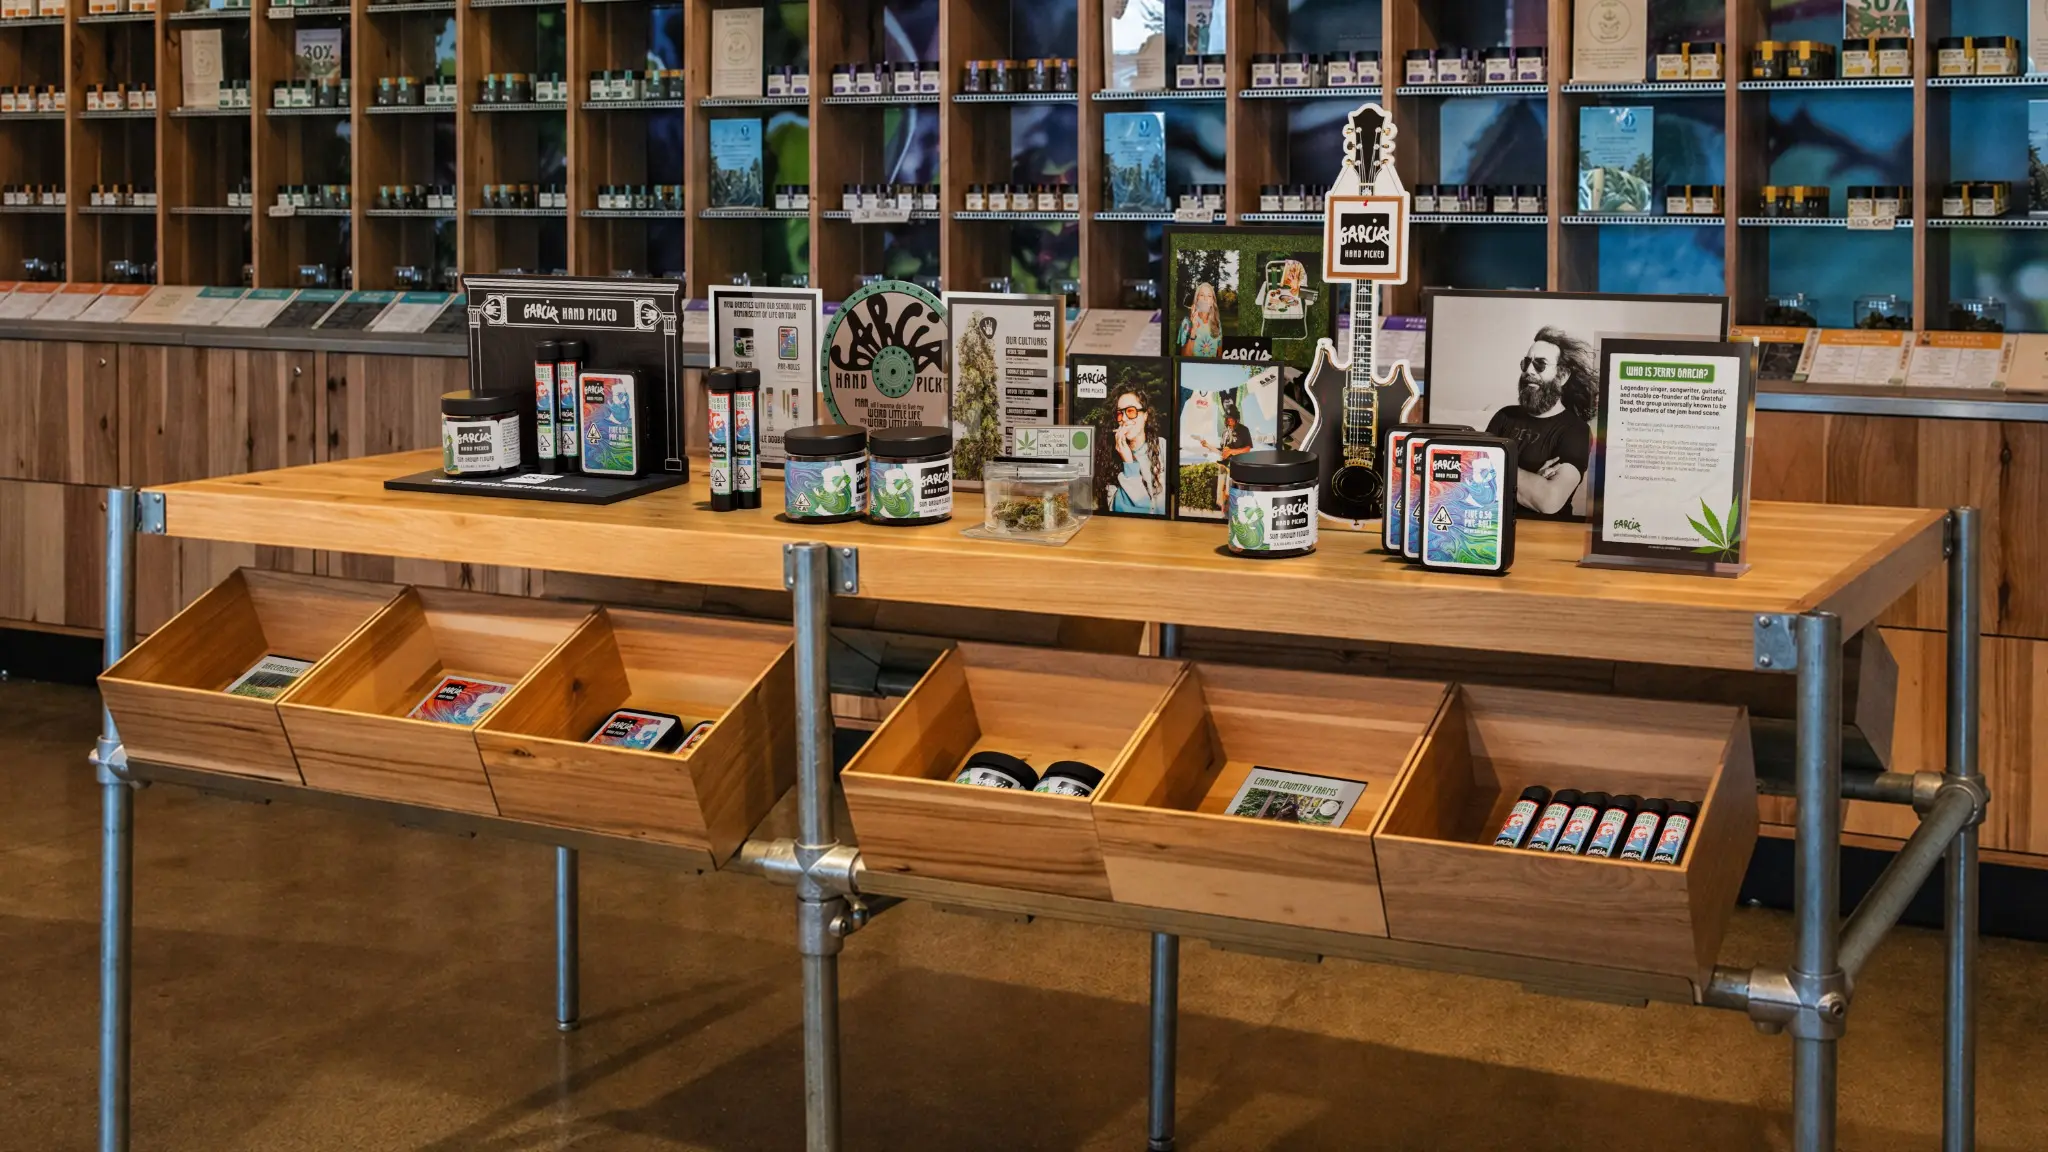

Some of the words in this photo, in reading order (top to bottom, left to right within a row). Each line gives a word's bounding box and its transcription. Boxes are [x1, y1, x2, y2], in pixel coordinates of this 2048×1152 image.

[1344, 250, 1361, 258] HAND
[1364, 250, 1384, 258] PICKED
[776, 302, 792, 310] SCHOOL
[562, 308, 584, 320] HAND
[588, 308, 618, 322] PICKED
[1006, 336, 1017, 344] OUR
[1018, 336, 1048, 346] CULTIVARS
[1626, 366, 1643, 376] WHO
[1645, 367, 1652, 377] IS
[1653, 367, 1676, 377] JERRY
[836, 372, 868, 390] HAND
[868, 408, 887, 418] WEIRD
[888, 409, 906, 419] LITTLE
[908, 410, 920, 420] LIFE
[1254, 777, 1279, 788] CANNA
[1280, 780, 1311, 792] COUNTRY
[1312, 785, 1338, 796] FARMS
